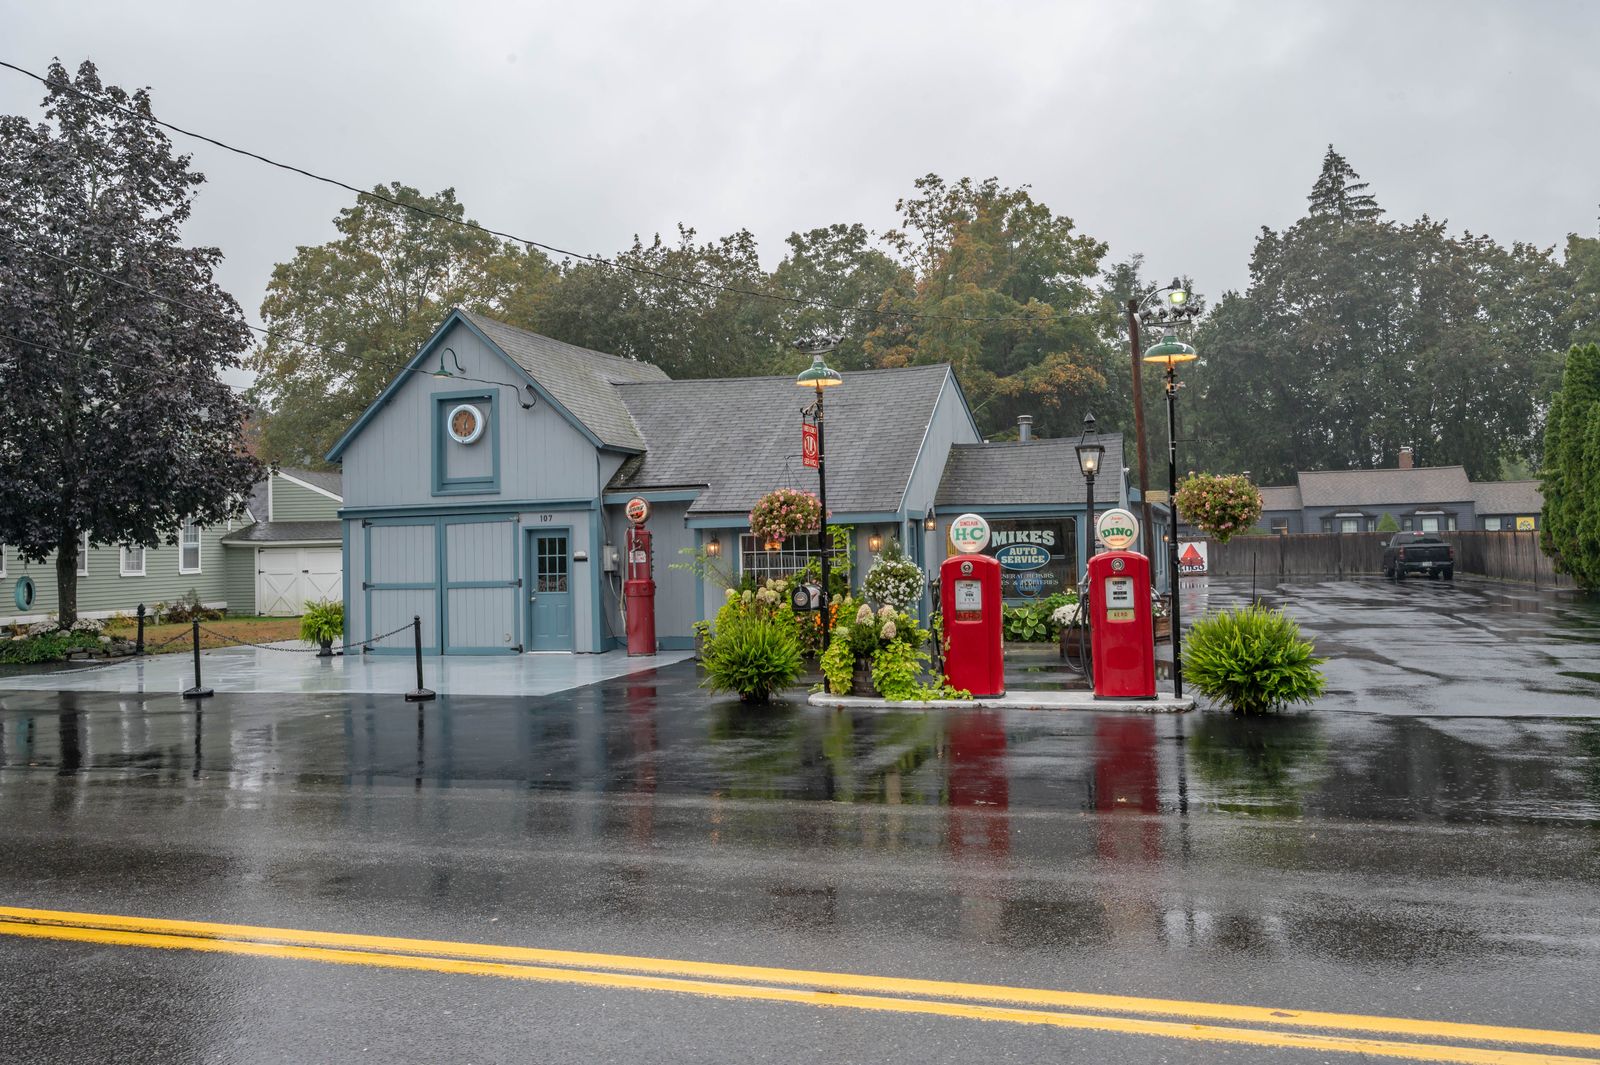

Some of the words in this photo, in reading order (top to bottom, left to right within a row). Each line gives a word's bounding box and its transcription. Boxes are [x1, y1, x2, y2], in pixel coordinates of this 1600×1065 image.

[540, 514, 552, 522] 107
[1102, 527, 1133, 537] DINO
[991, 530, 1055, 548] MIKES
[1009, 547, 1038, 555] AUTO
[1001, 555, 1046, 564] SERVICE
